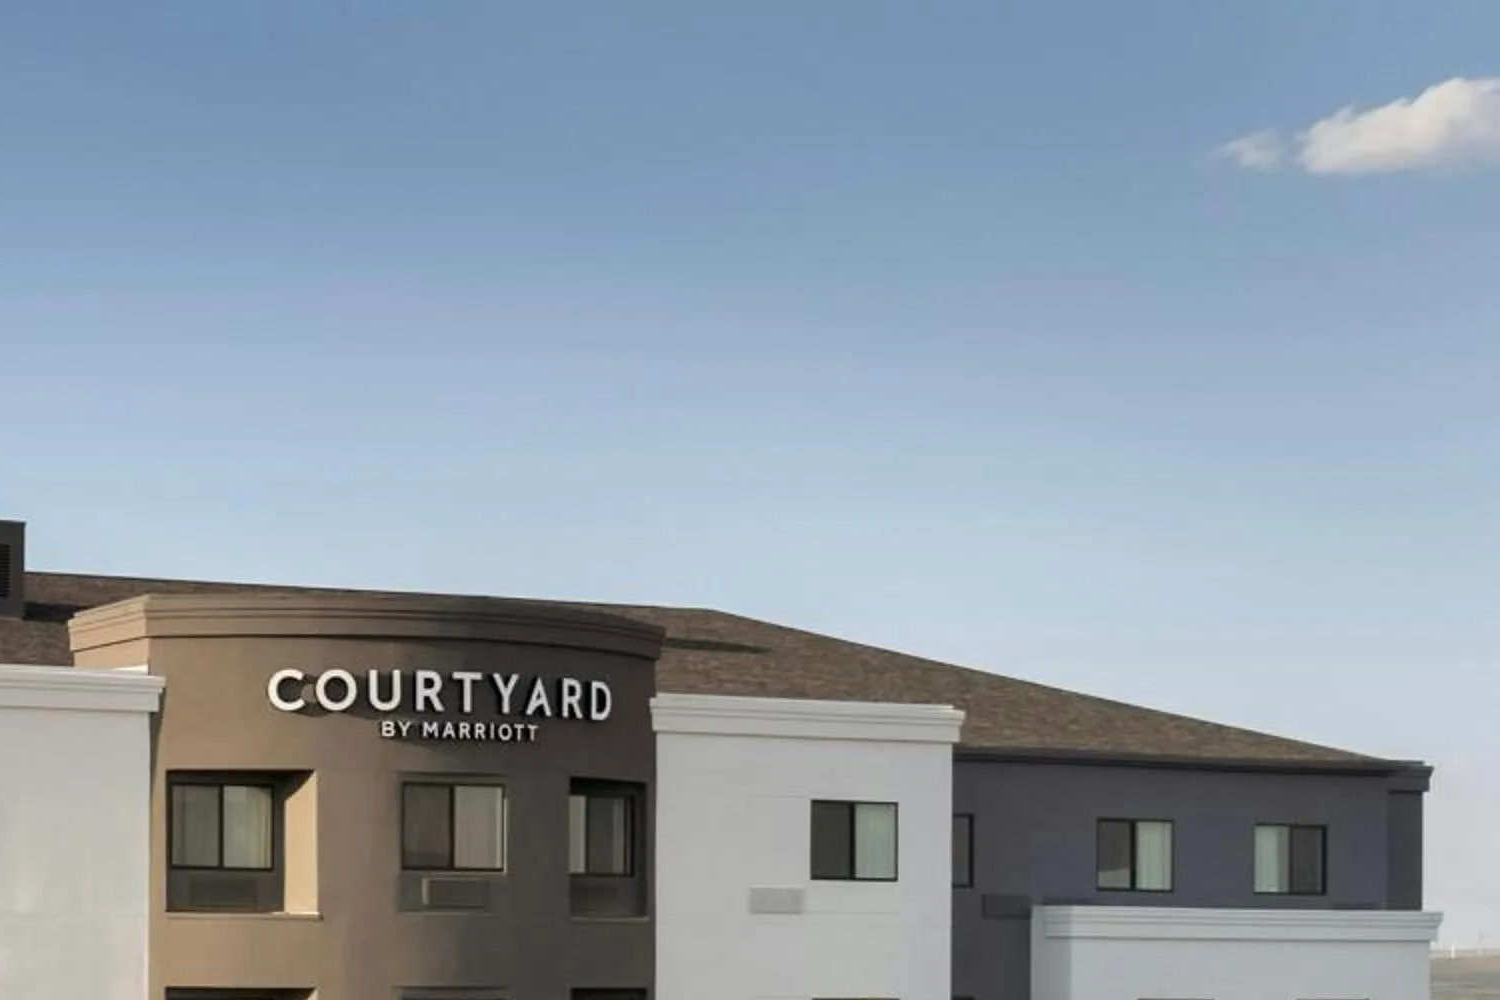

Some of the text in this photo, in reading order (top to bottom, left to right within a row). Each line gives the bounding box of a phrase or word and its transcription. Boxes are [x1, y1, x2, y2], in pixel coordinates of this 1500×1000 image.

[266, 668, 613, 721] COURTYARD
[381, 720, 540, 741] BY MARRIOTT
